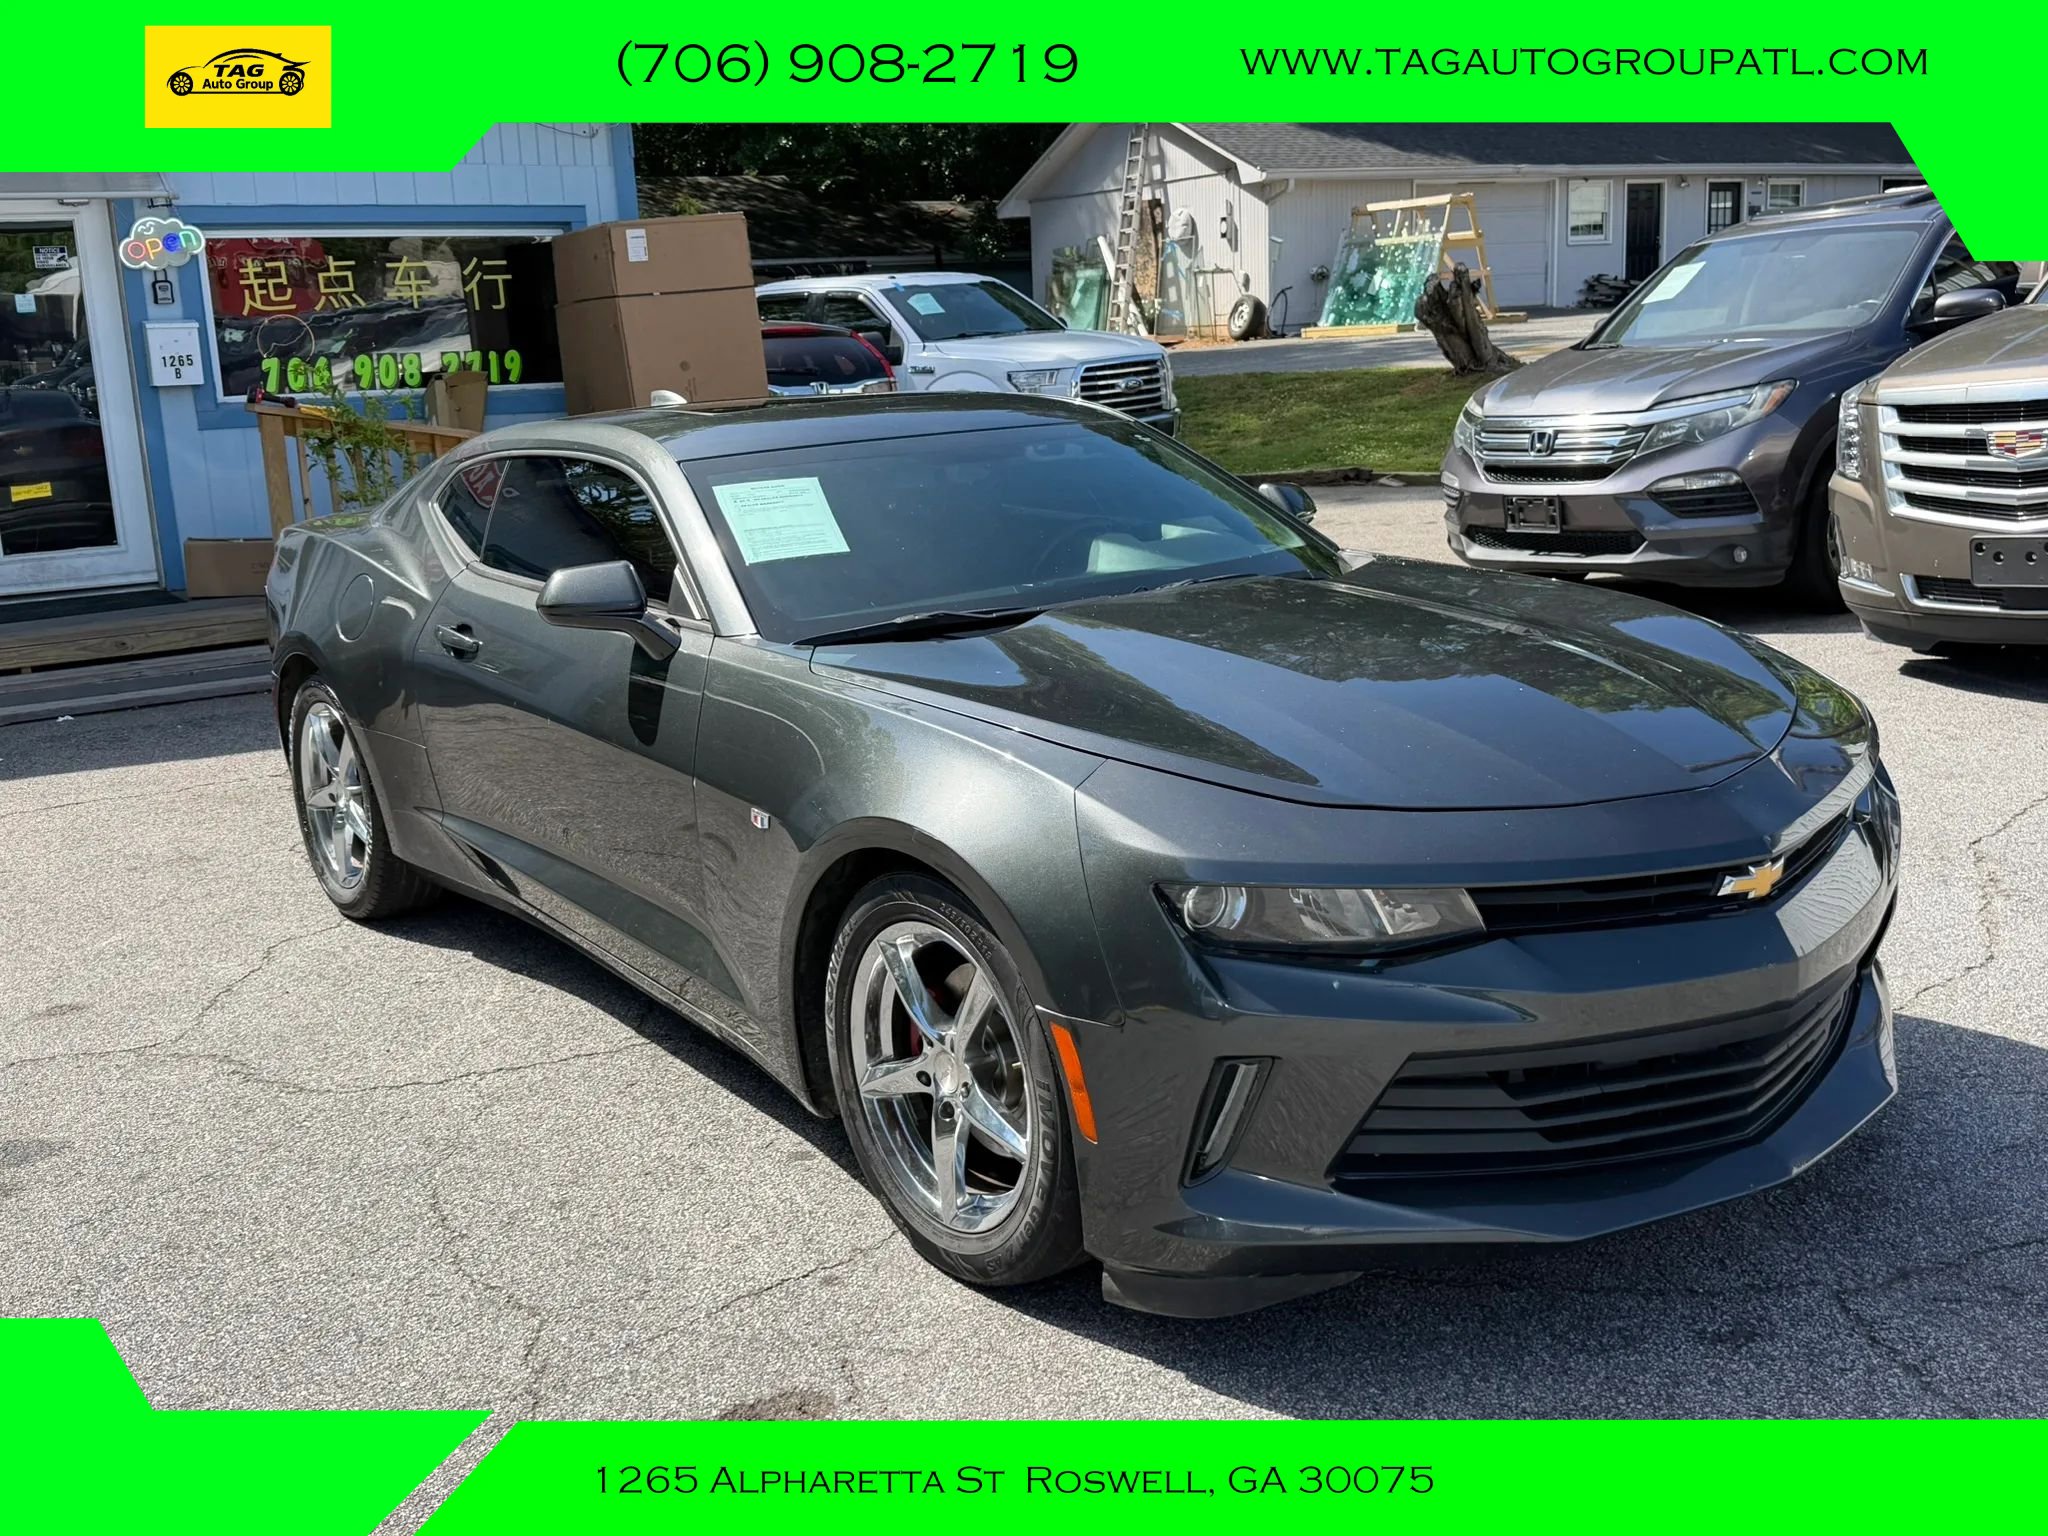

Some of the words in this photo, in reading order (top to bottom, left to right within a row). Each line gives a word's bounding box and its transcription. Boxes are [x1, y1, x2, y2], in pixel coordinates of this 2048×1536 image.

[239, 255, 512, 316] 起点车行
[161, 354, 194, 367] 1265
[354, 353, 423, 389] 908
[175, 367, 182, 379] B
